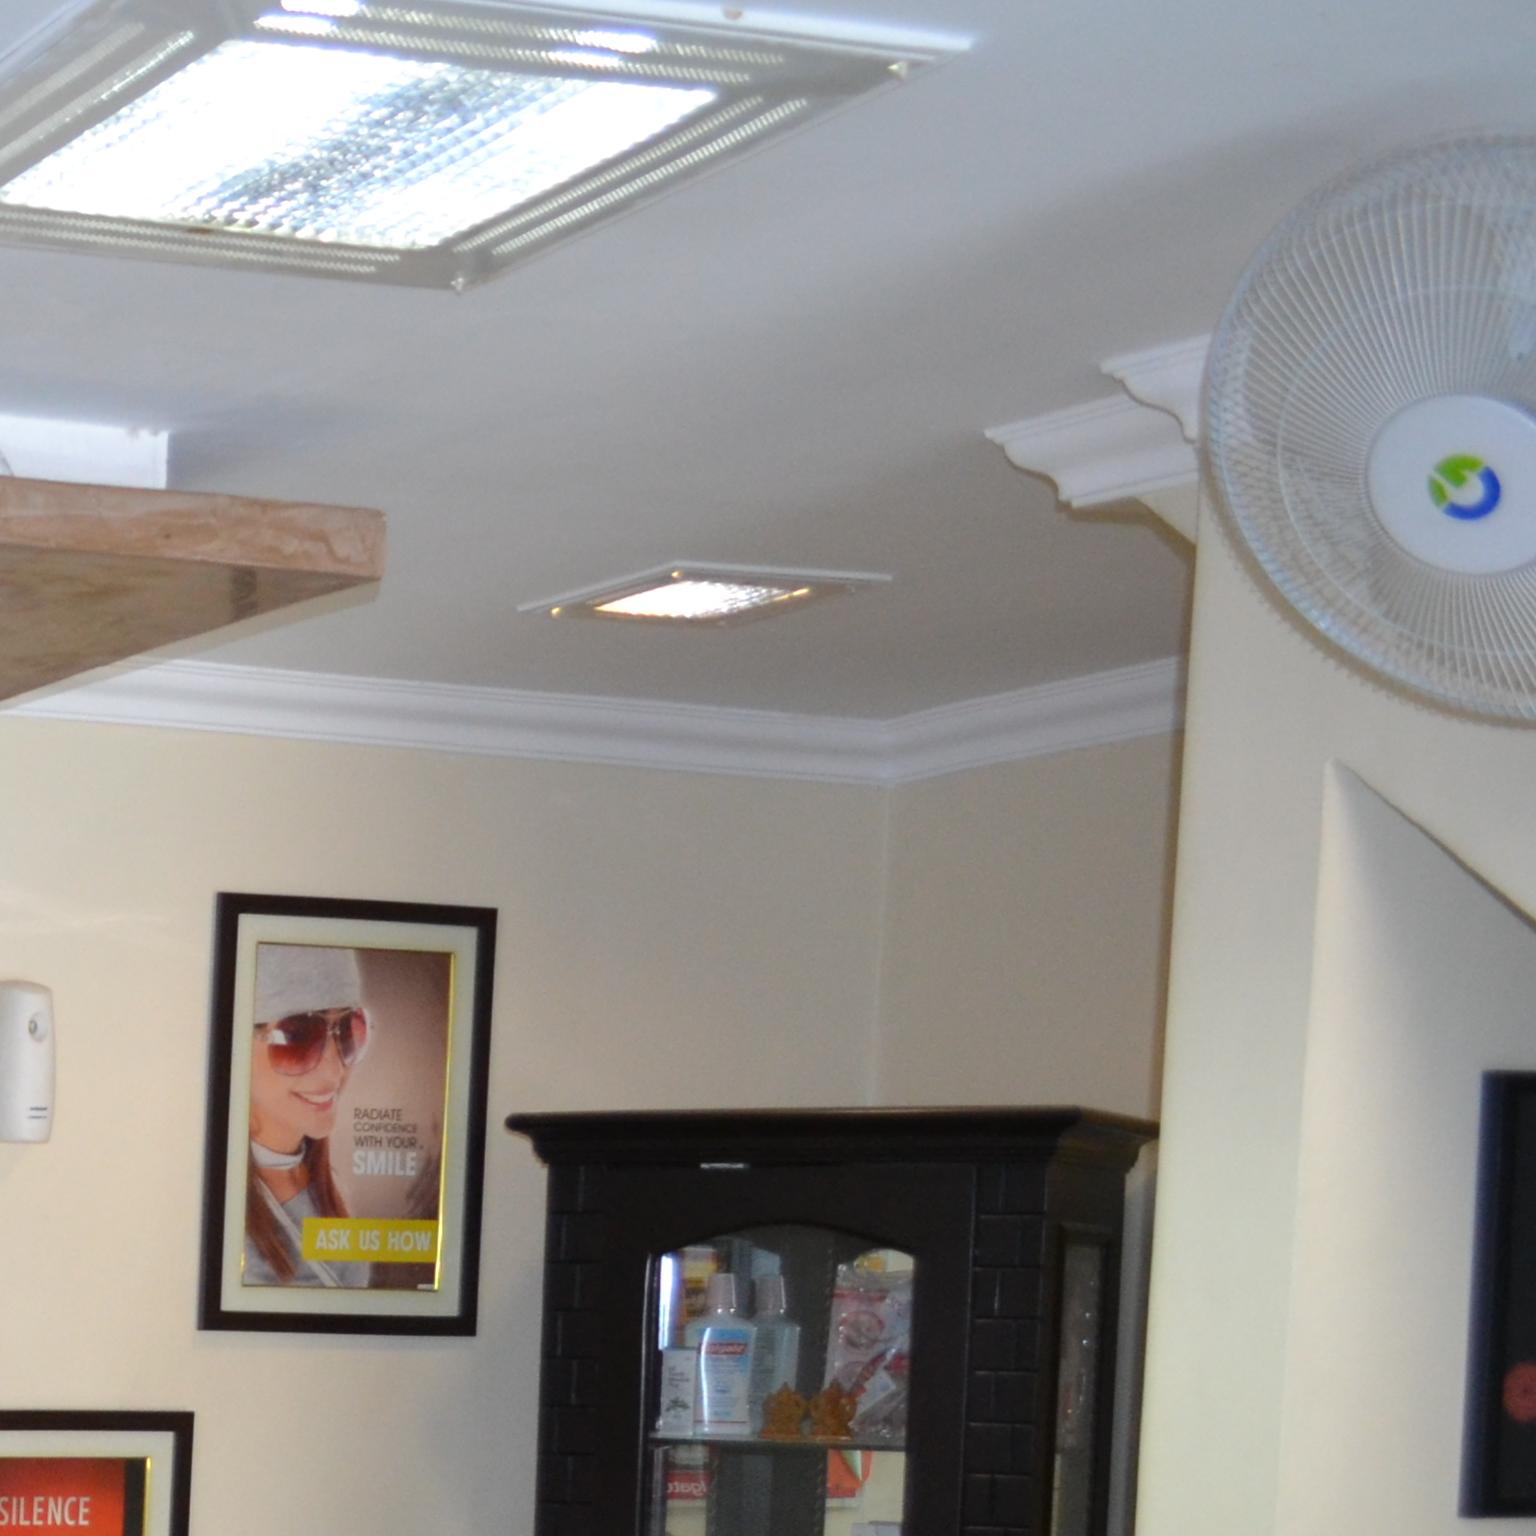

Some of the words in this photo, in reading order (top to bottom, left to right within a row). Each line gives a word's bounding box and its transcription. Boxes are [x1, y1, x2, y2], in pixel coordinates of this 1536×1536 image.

[353, 1107, 403, 1121] RADIATE
[353, 1121, 417, 1133] CONFIDENCE
[353, 1135, 383, 1148] WITH
[385, 1136, 417, 1149] YOUR
[353, 1150, 416, 1176] SMILE
[315, 1228, 352, 1251] ASK
[359, 1229, 381, 1251] US
[386, 1230, 432, 1252] HOW
